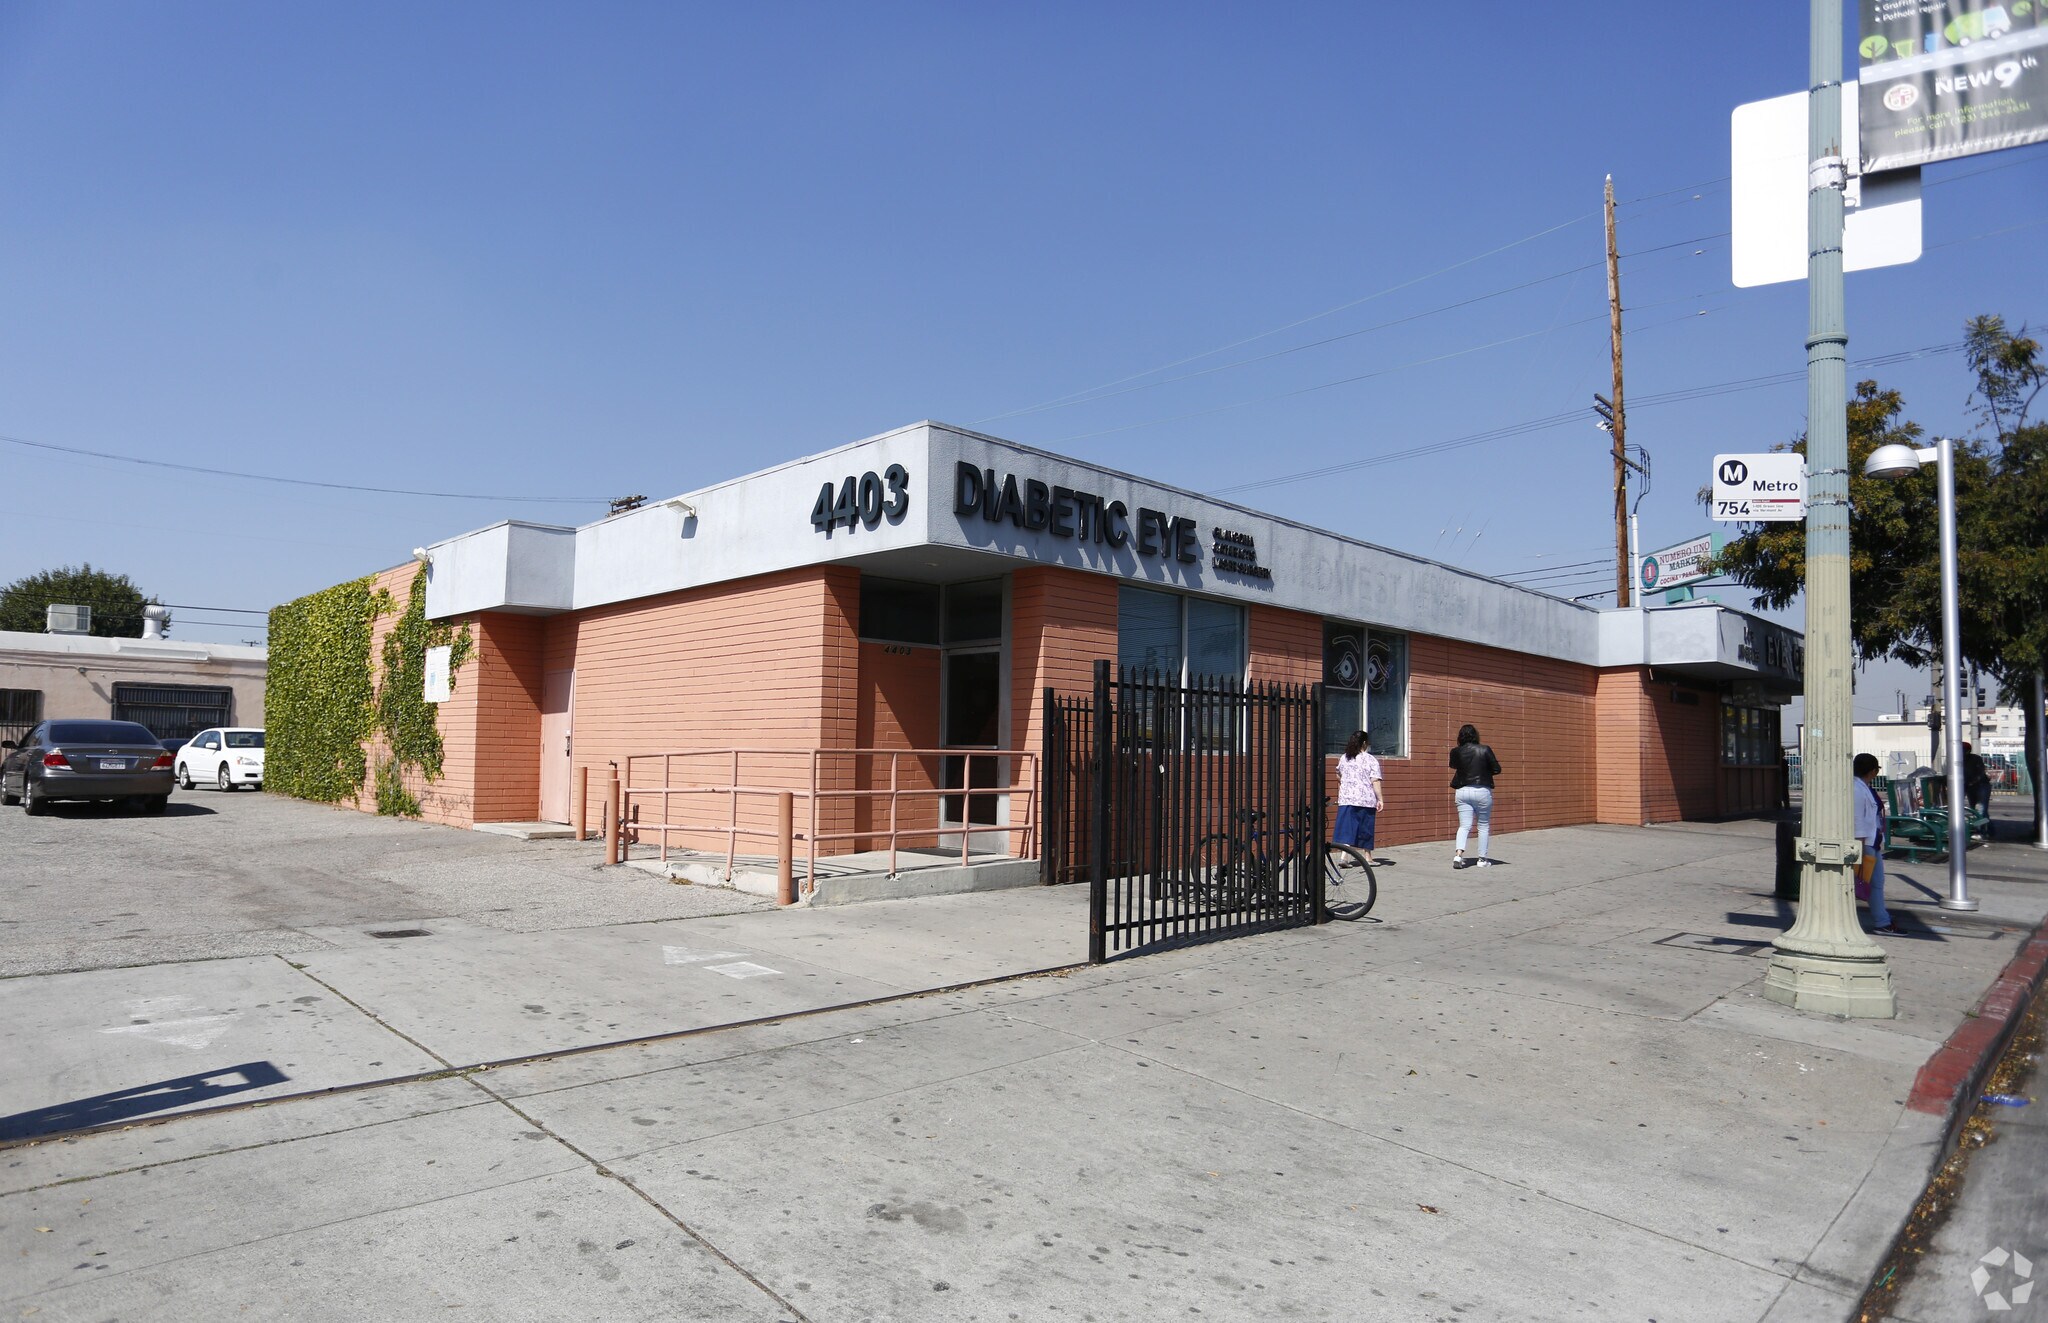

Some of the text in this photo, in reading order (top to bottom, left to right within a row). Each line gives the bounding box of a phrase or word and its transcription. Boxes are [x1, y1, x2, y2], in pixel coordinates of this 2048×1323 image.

[1883, 2, 1947, 21] Pothole repair
[1935, 70, 1994, 96] NEW
[1907, 116, 1923, 126] For
[1926, 110, 1952, 121] more
[1894, 125, 1926, 138] please
[1929, 120, 1946, 130] call
[1753, 480, 1798, 492] Metro
[811, 463, 909, 531] 4403
[953, 460, 1197, 563] DIABETIC EYE
[1718, 501, 1750, 515] 754
[1659, 541, 1710, 564] NUMERO UNO
[1669, 555, 1701, 571] MARKET
[1660, 575, 1679, 585] COCINA
[884, 645, 912, 656] 4403
[1766, 635, 1788, 668] EYE
